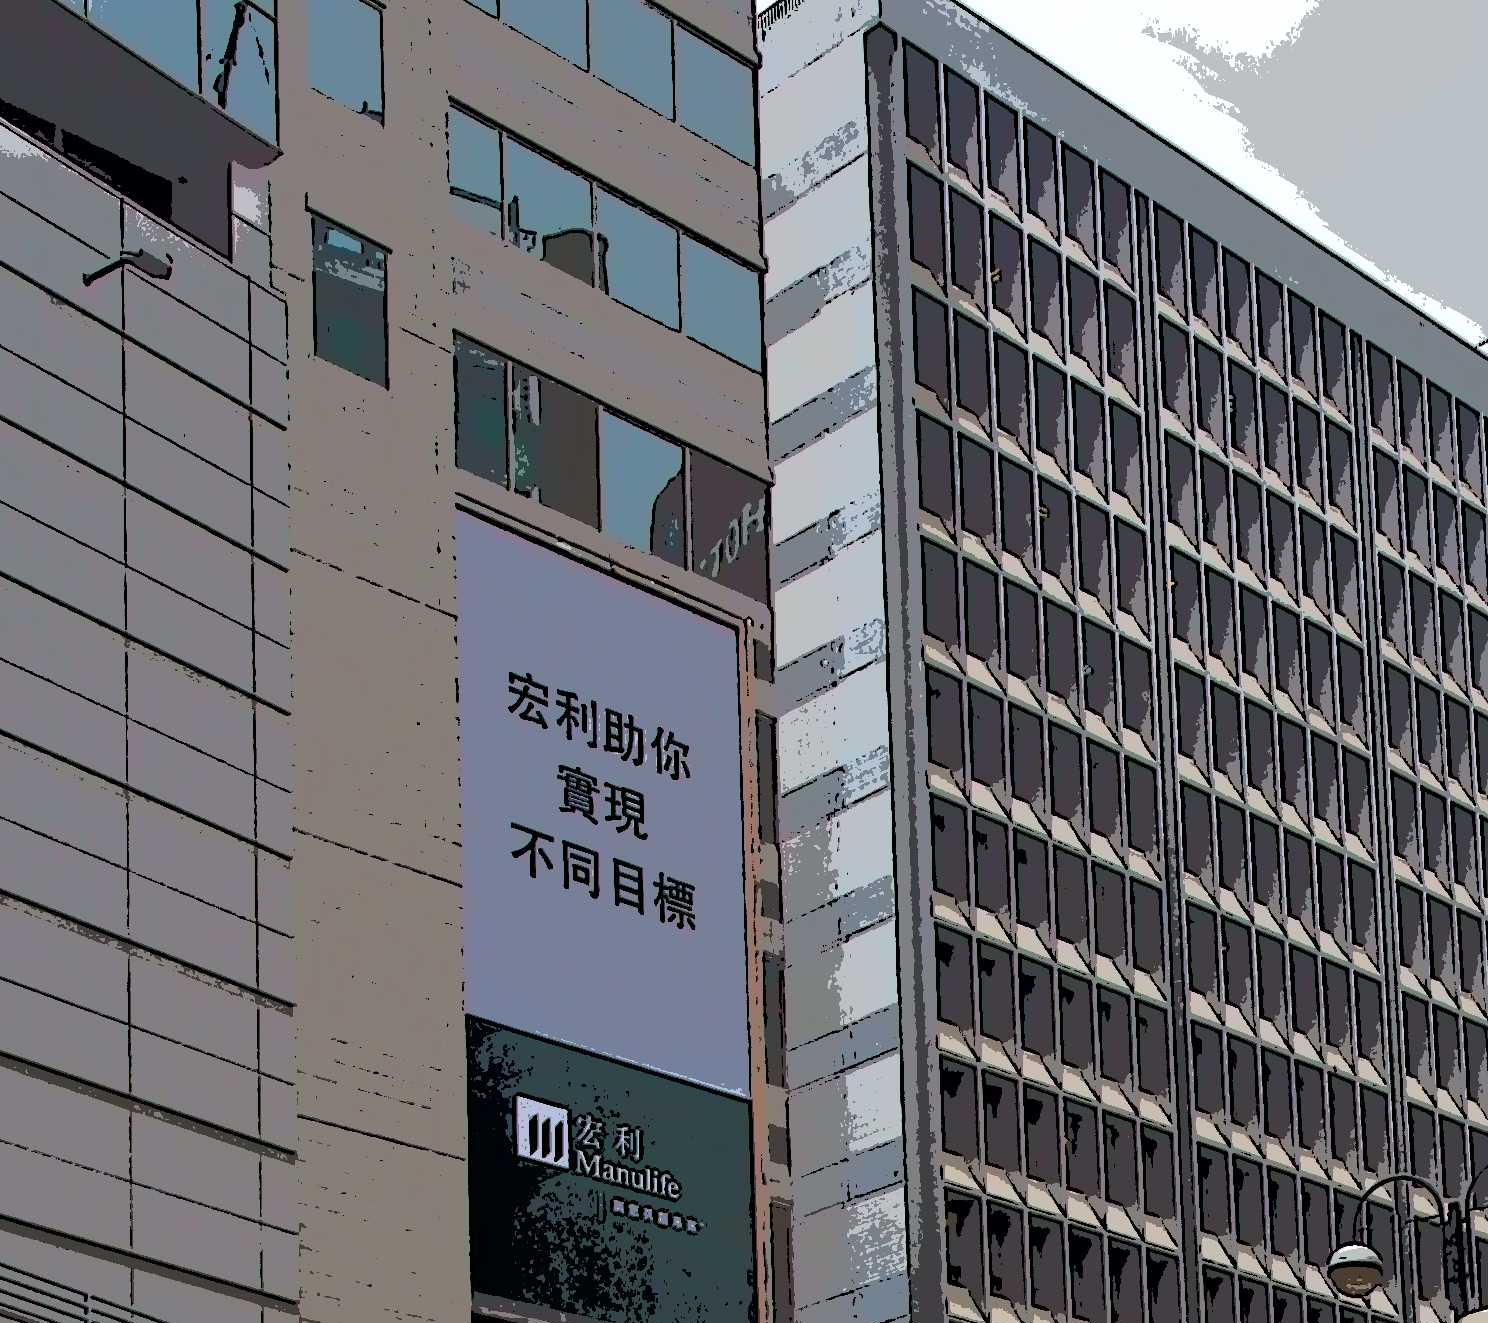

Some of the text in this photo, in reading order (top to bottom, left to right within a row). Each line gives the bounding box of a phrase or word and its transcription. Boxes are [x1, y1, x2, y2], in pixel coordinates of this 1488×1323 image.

[507, 671, 691, 781] 宏利助你
[557, 765, 648, 840] 實現
[511, 822, 697, 930] 不同目標
[574, 1149, 682, 1201] Manulife
[575, 1114, 643, 1162] 宏利
